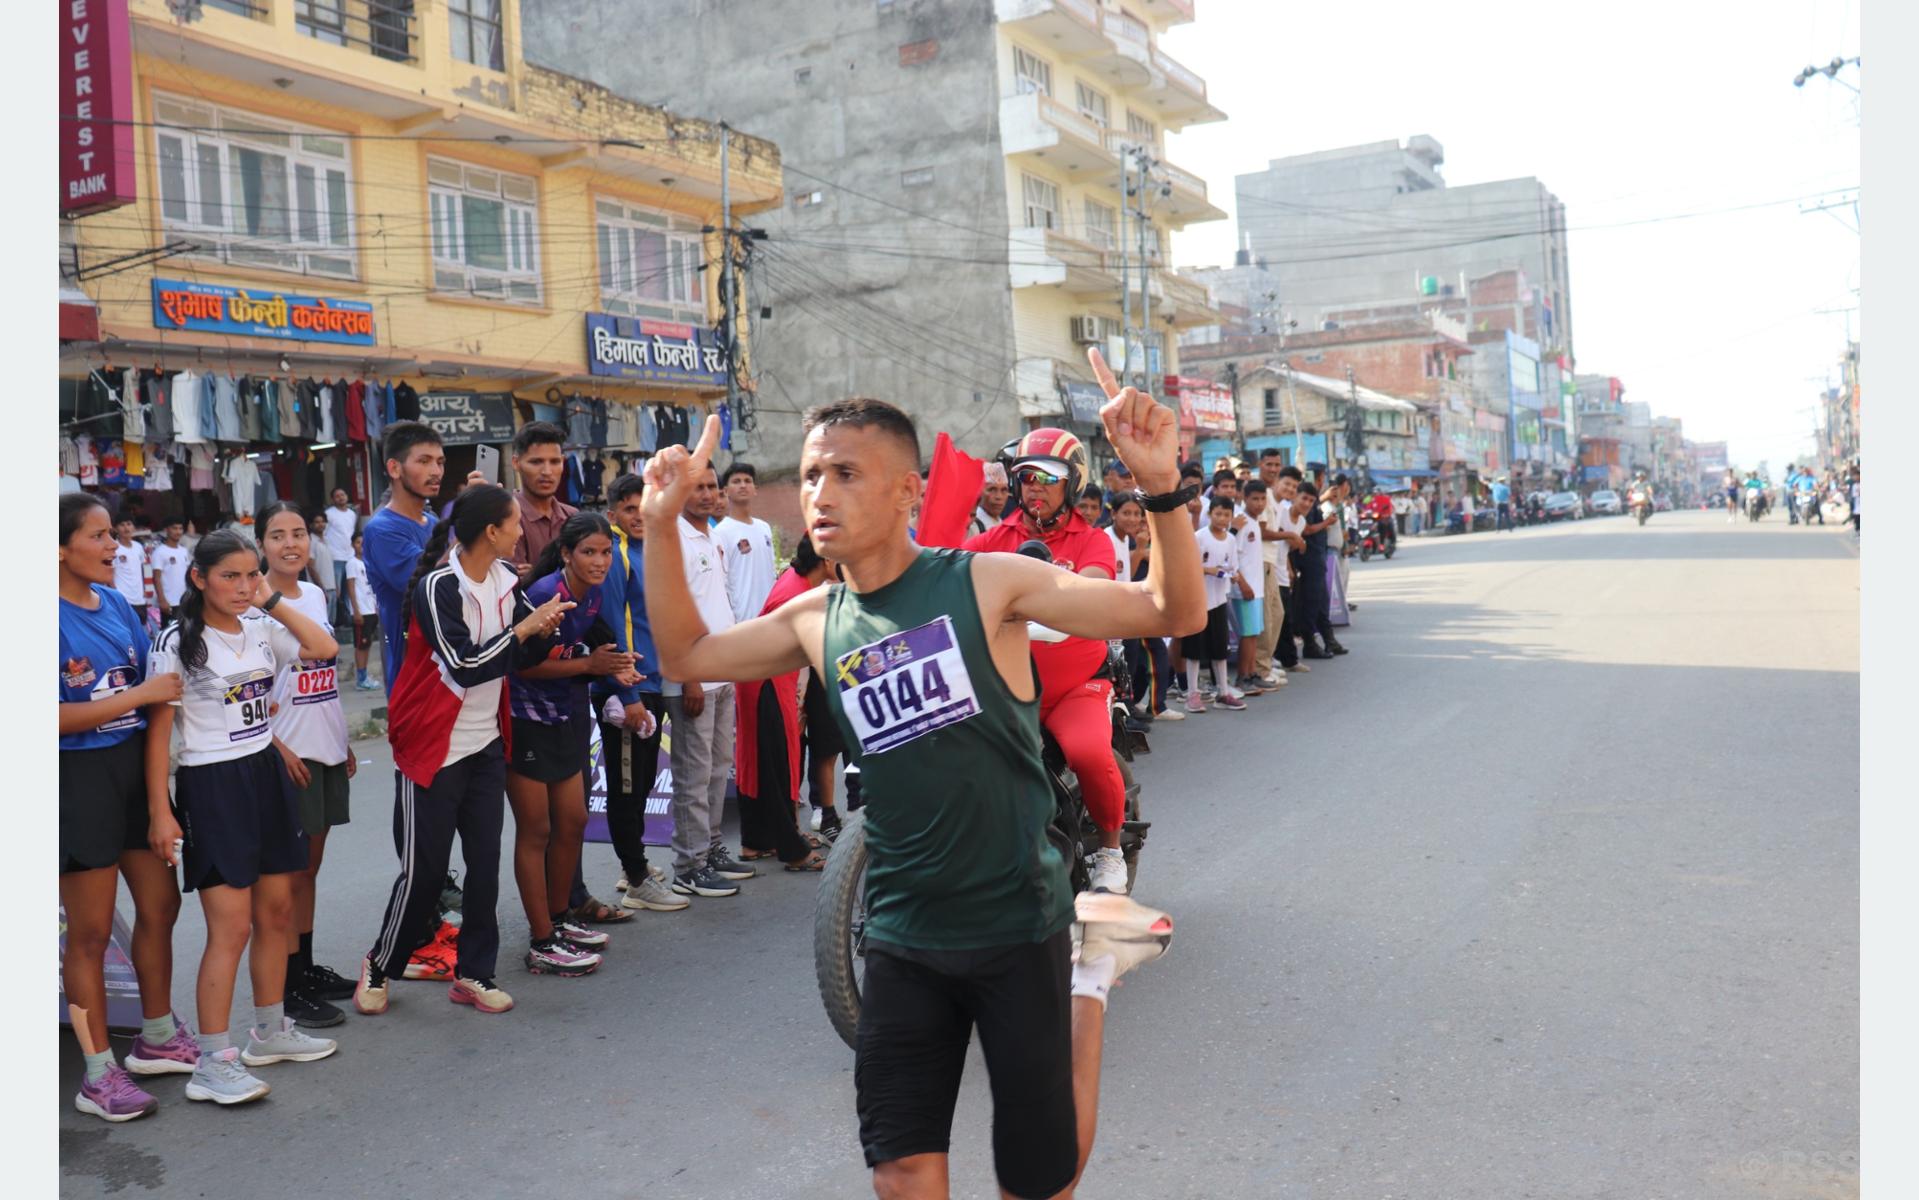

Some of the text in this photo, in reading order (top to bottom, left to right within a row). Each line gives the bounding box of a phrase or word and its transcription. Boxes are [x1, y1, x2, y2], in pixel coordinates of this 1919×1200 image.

[71, 0, 94, 172] EVEREST
[69, 173, 107, 199] BANK
[593, 325, 649, 367] हिमाल
[297, 668, 335, 695] 0222
[857, 658, 952, 729] 0144
